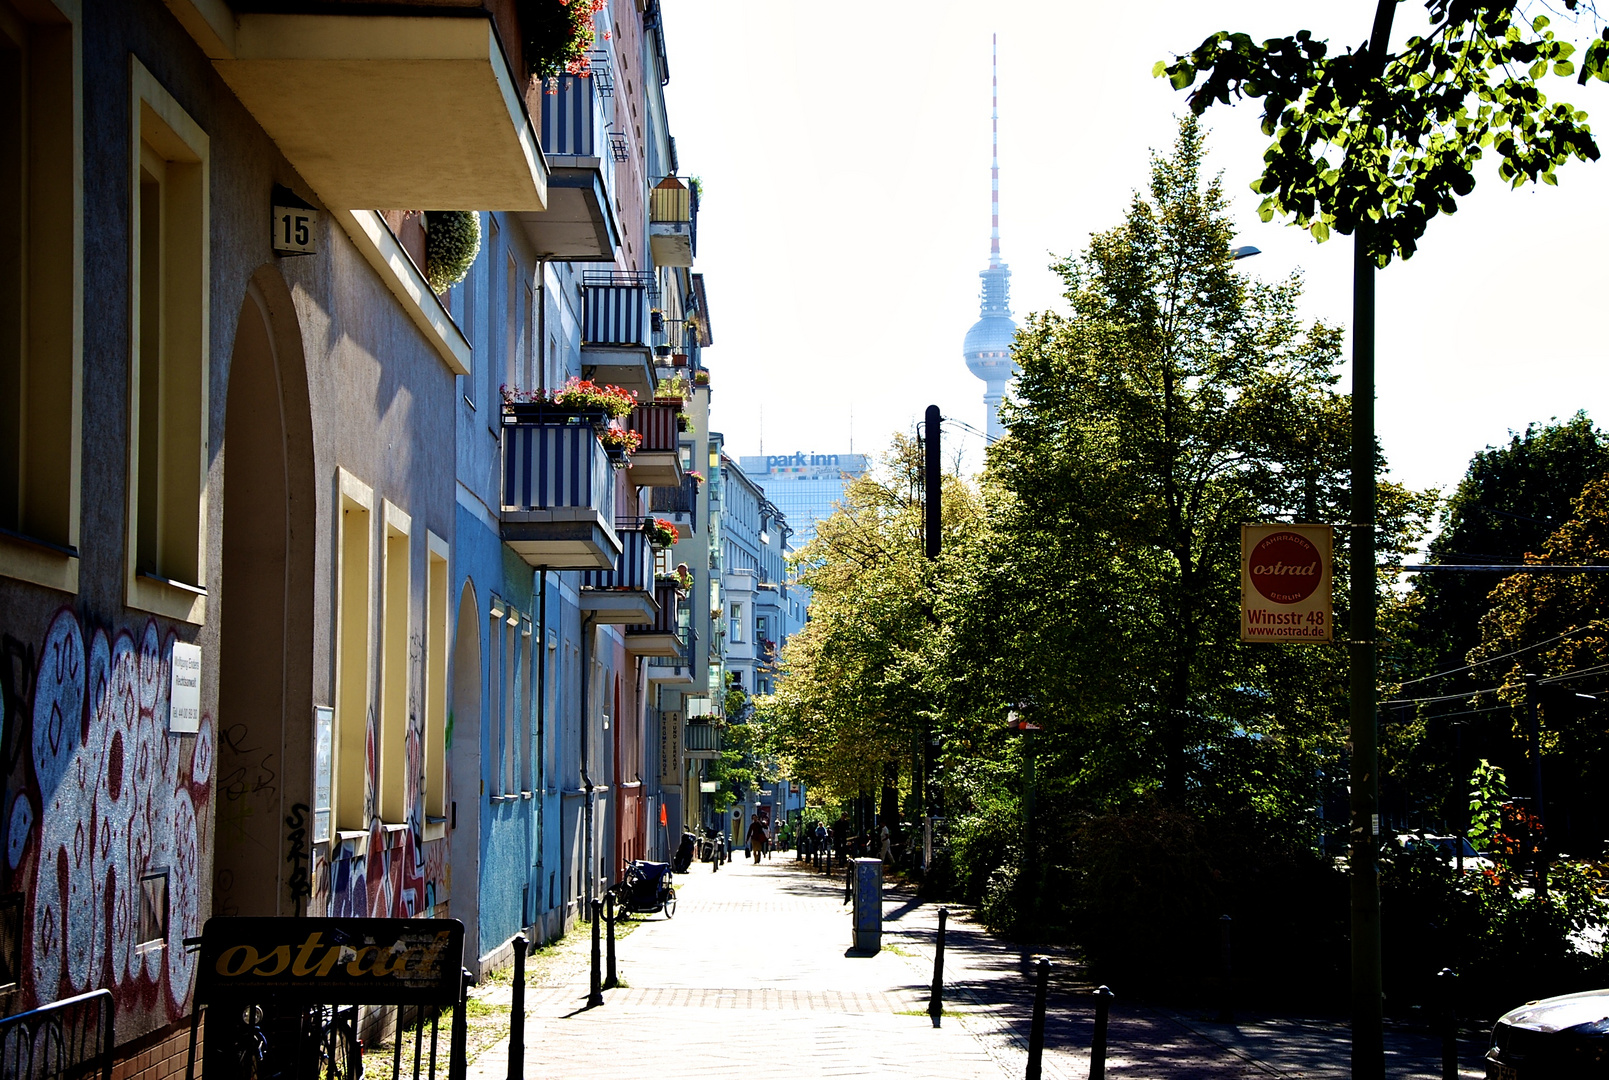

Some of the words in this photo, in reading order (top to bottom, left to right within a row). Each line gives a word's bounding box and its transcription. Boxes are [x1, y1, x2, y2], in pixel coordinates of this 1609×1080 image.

[282, 214, 309, 246] 15
[766, 450, 807, 474] park
[810, 451, 839, 466] inn
[1253, 561, 1316, 576] ostrad
[1270, 591, 1302, 602] BERLIN
[1247, 609, 1304, 625] Winsstr
[1306, 610, 1325, 626] 48
[1247, 626, 1325, 637] www.ostrad.de
[175, 674, 197, 687] Rechtsanwalt
